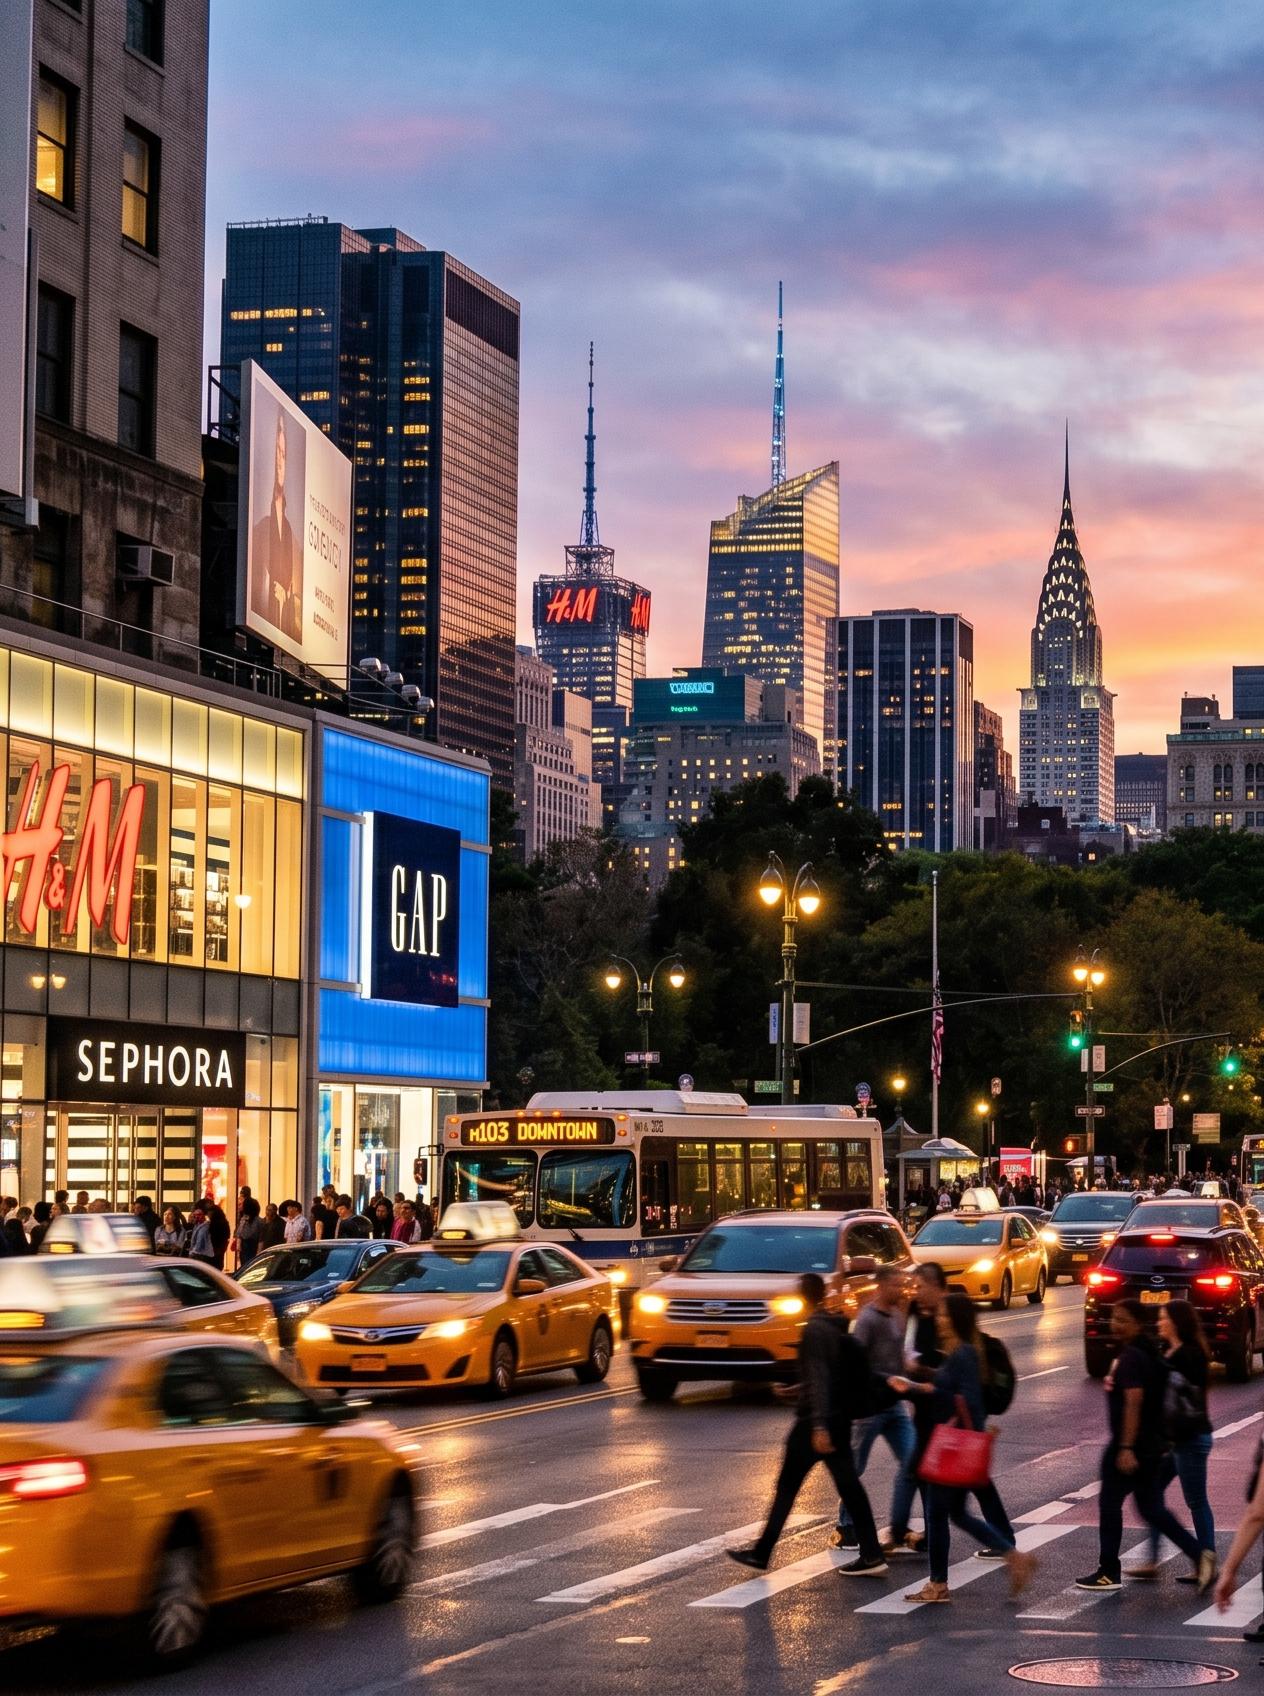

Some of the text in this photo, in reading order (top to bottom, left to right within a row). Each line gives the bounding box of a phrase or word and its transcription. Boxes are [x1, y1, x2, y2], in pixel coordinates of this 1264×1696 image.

[546, 587, 598, 623] H&M
[631, 592, 650, 631] H&M
[0, 760, 146, 945] H&M
[391, 864, 447, 957] GAP
[77, 1039, 234, 1089] SEPHORA
[469, 1121, 597, 1142] M103 DOWNTOWN
